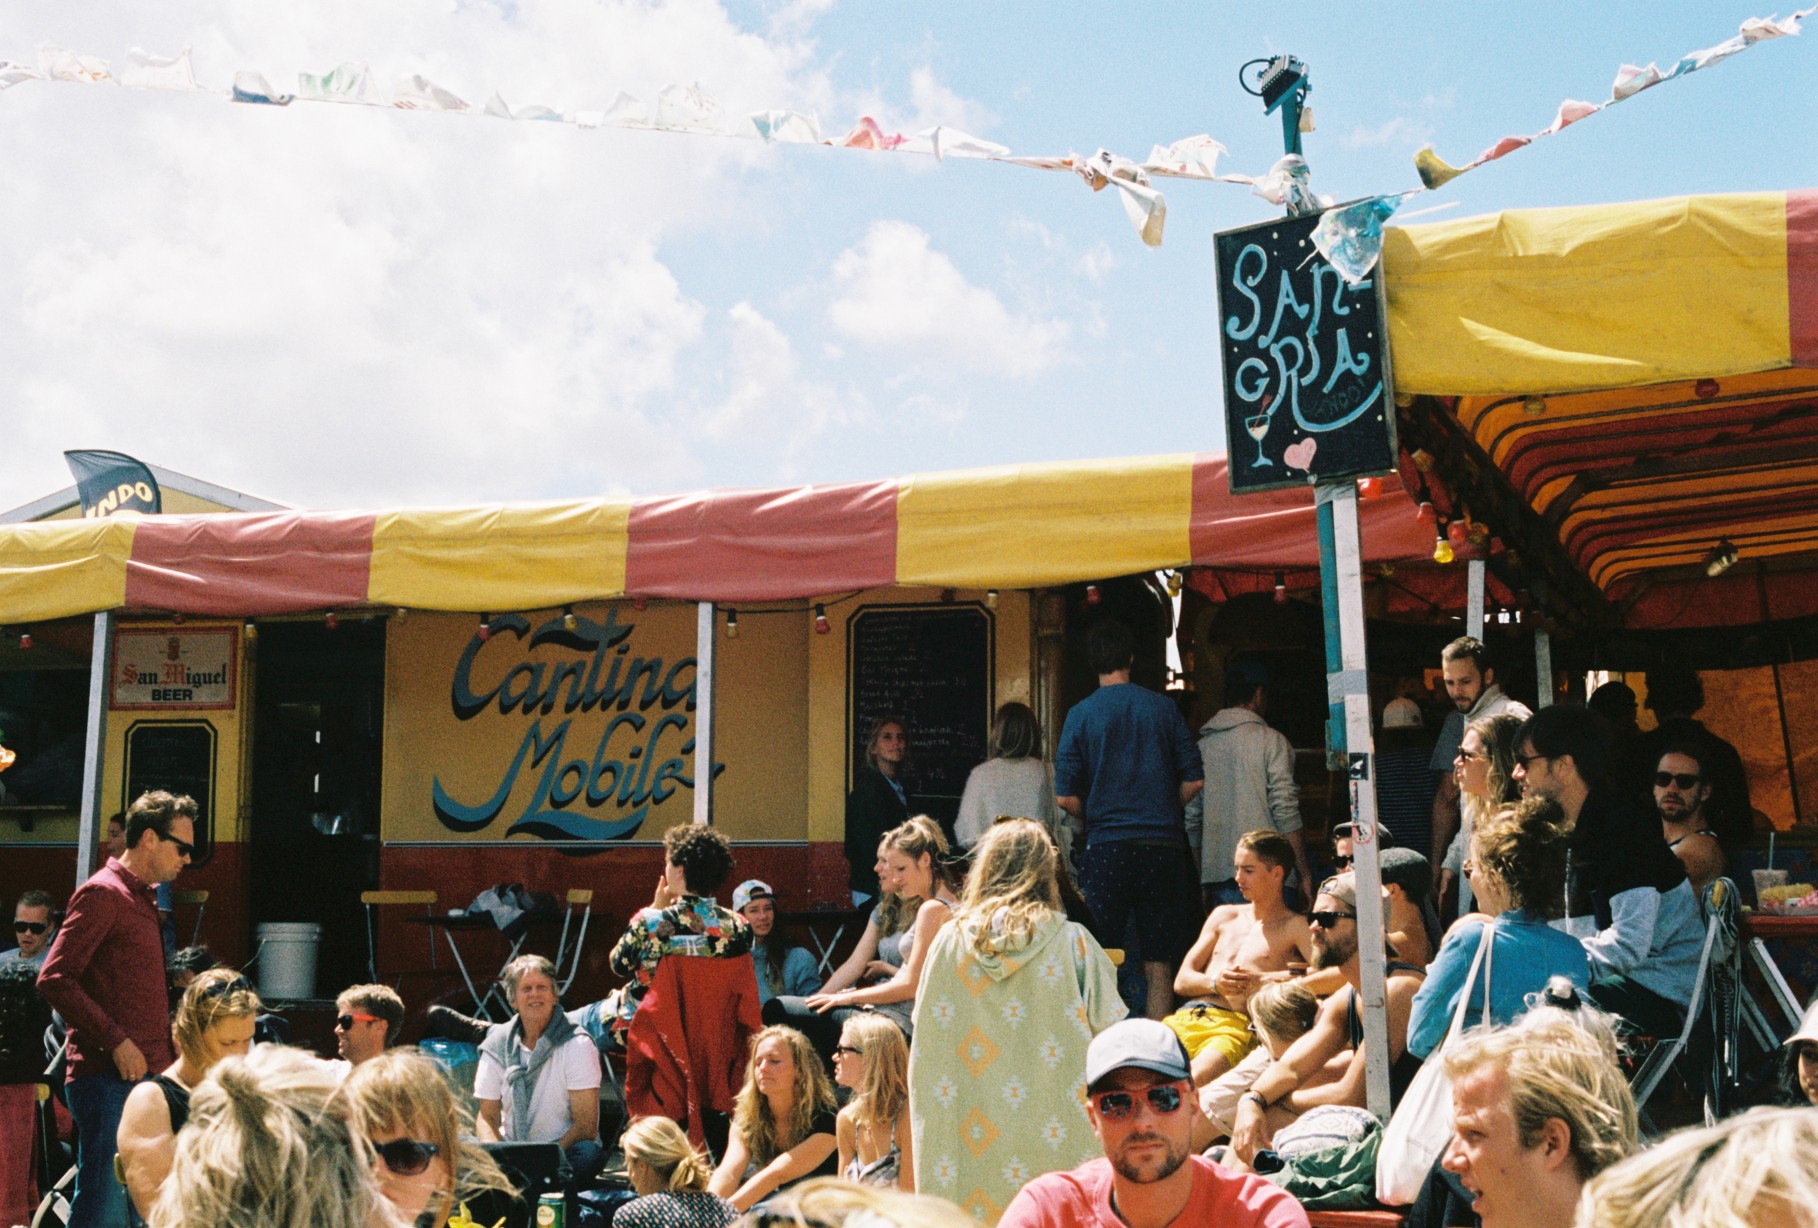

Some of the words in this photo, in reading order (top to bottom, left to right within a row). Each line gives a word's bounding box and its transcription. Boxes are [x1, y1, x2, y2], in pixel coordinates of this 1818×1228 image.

[1234, 327, 1383, 432] GRIA
[119, 663, 158, 689] San
[160, 663, 227, 688] Miguel
[151, 688, 193, 701] BEER
[452, 606, 698, 721] Cantina
